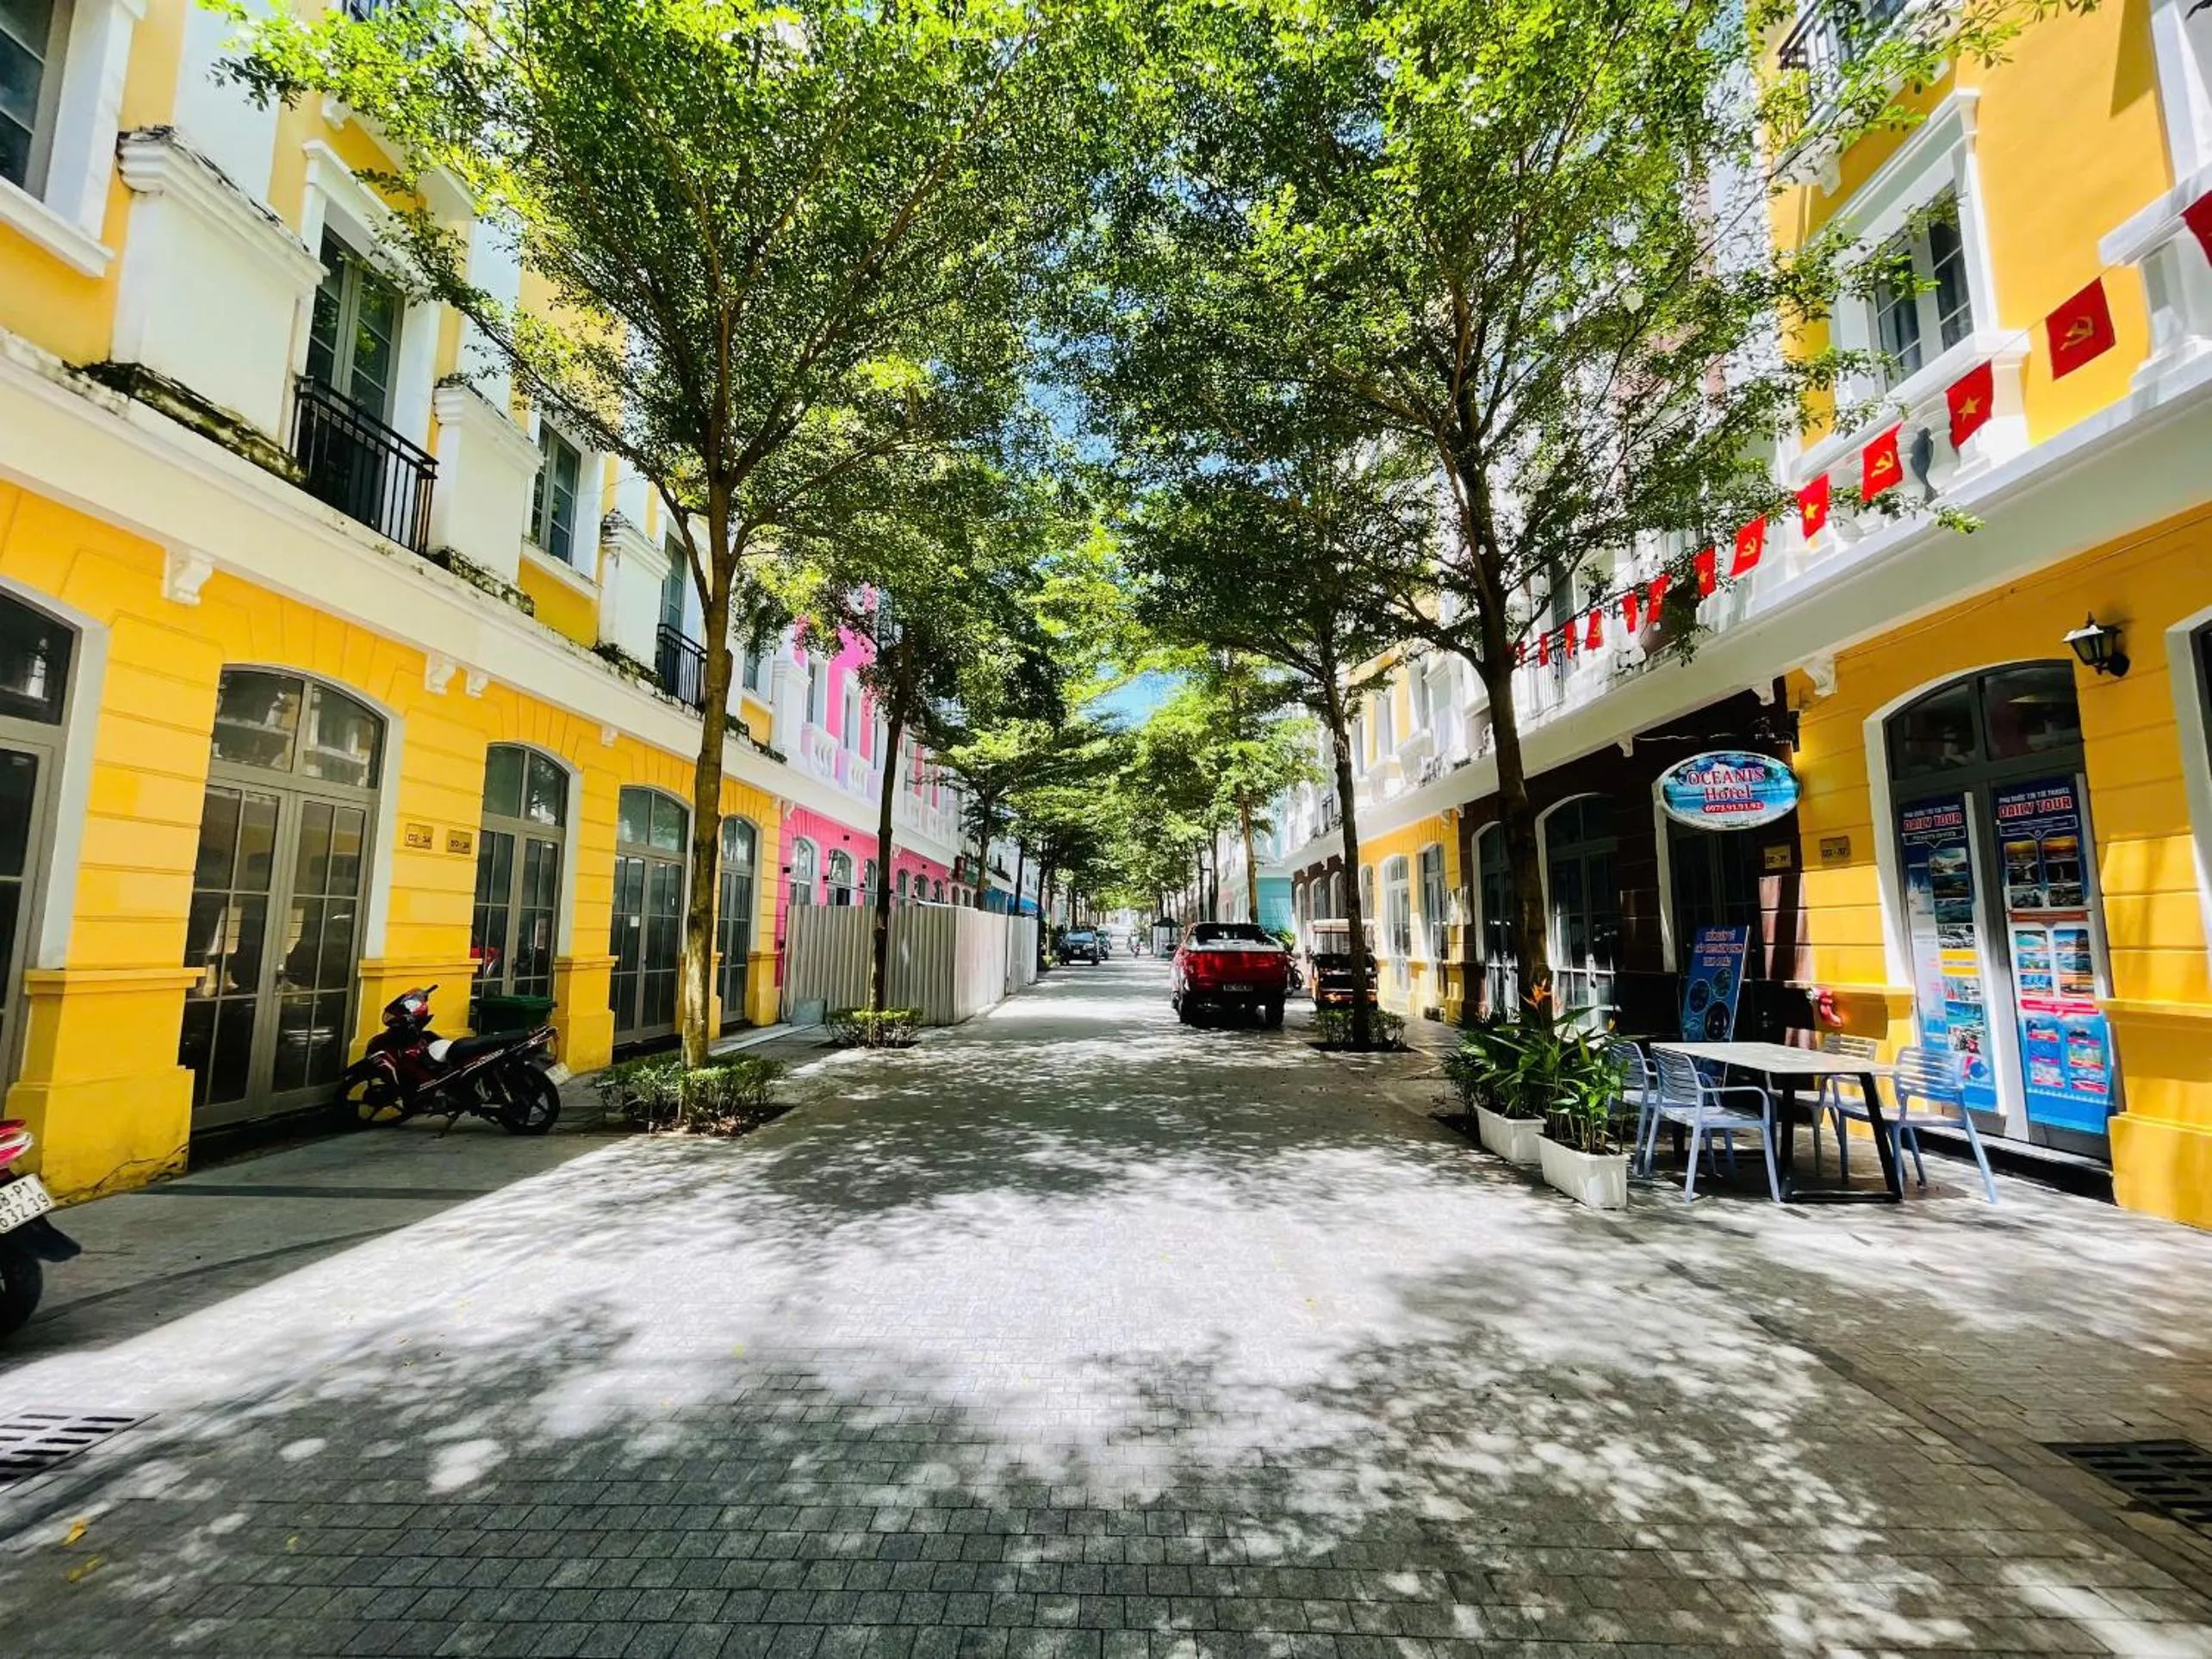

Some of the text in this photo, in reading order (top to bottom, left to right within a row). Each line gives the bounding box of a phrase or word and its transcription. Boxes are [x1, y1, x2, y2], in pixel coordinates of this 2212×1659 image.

[1687, 767, 1765, 786] OCEANIS
[1705, 785, 1752, 801] Hotel
[1998, 796, 2072, 818] DAILY TOUR
[1903, 812, 1962, 832] DAILY TOUR
[0, 1181, 34, 1209] 8-P1
